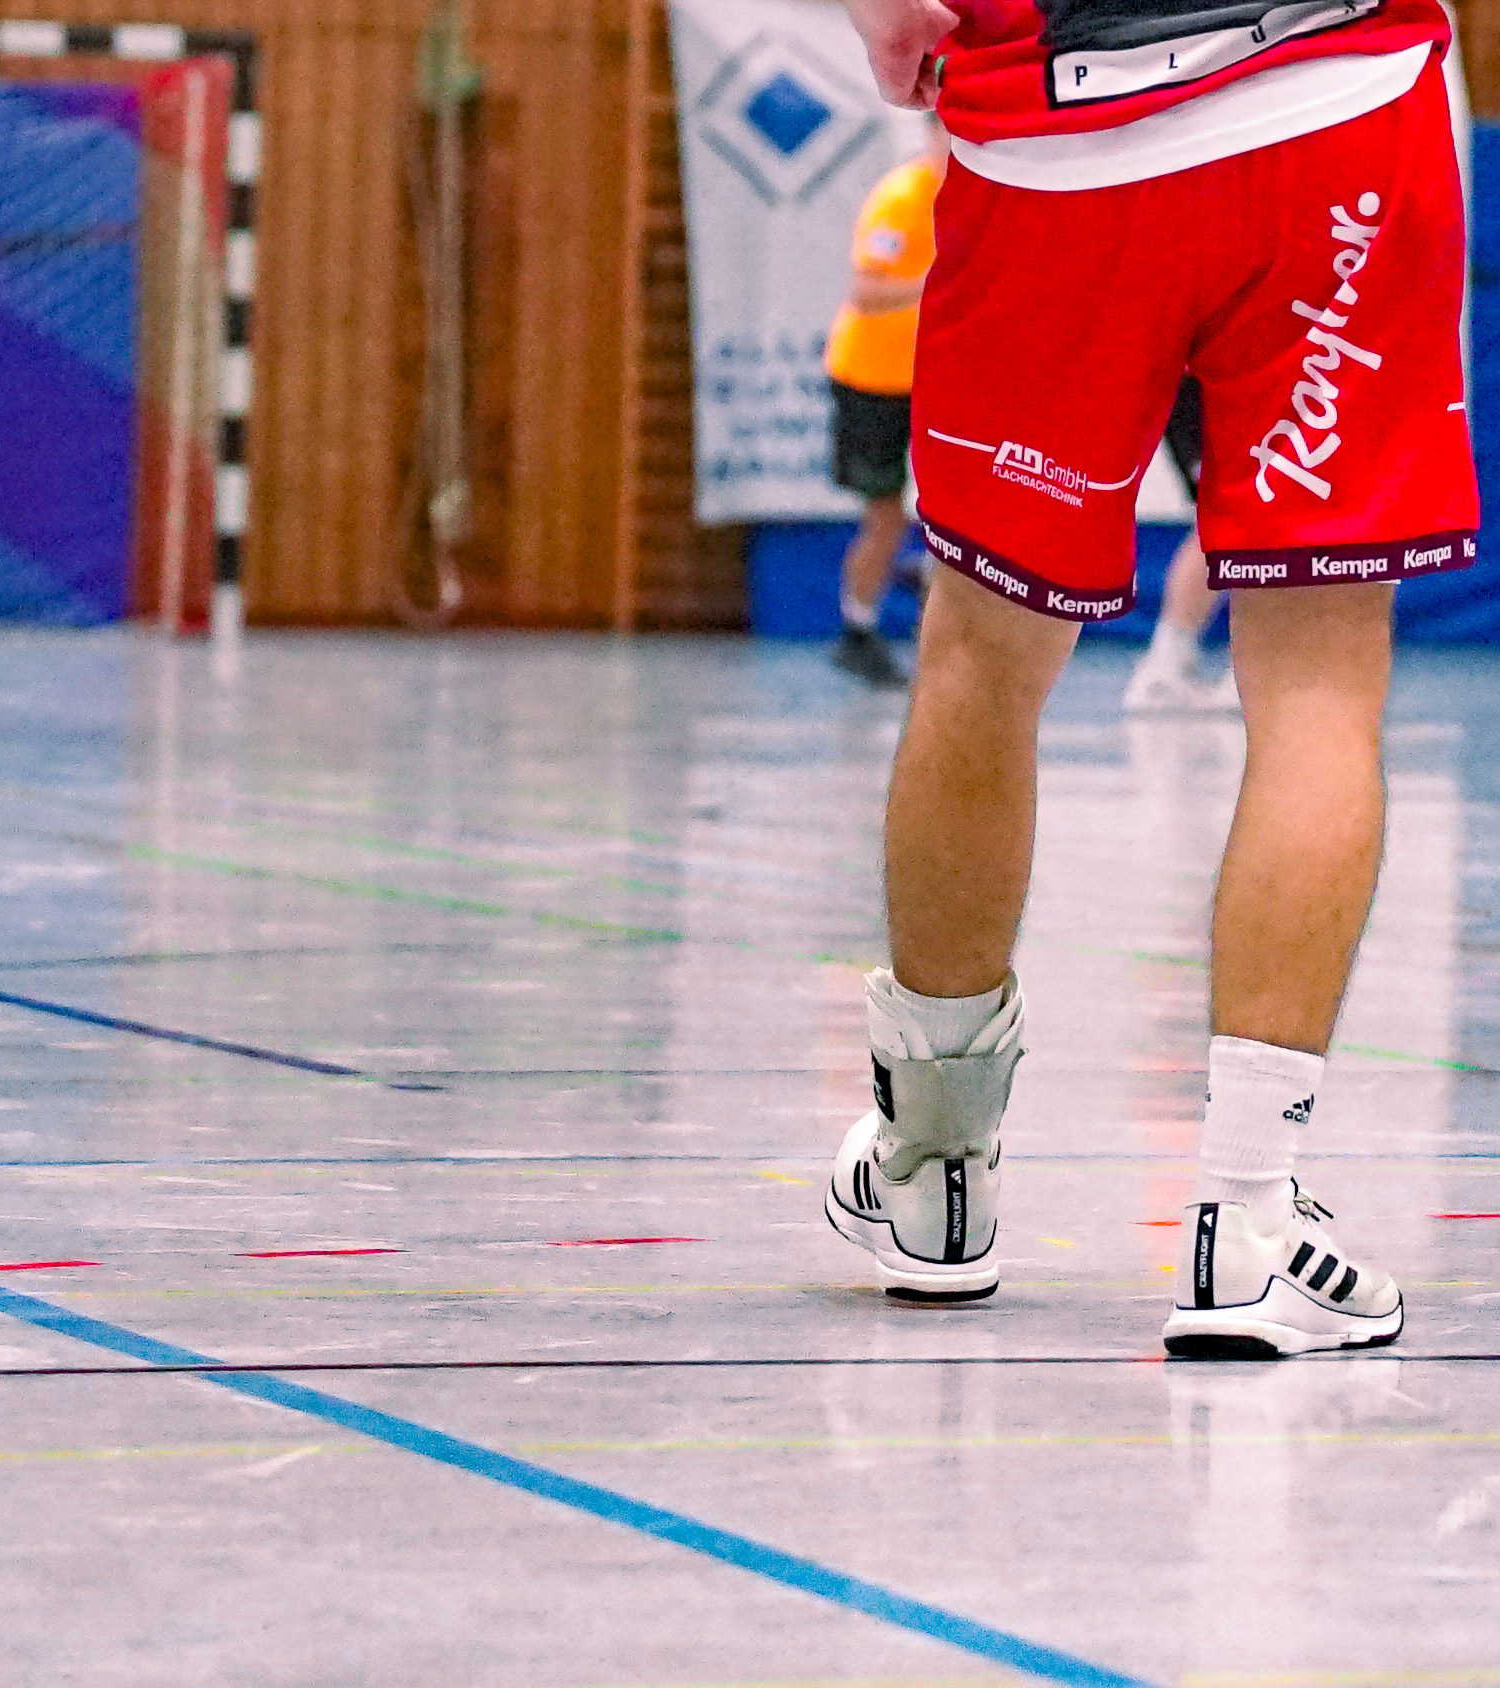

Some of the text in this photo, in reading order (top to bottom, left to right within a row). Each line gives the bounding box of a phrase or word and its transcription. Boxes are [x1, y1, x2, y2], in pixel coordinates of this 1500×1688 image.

[1043, 456, 1089, 494] GmbH
[1218, 558, 1289, 585] Kempa
[1310, 554, 1389, 579] Kempa
[1403, 544, 1453, 570] Kempa
[973, 553, 1030, 600] Kempa
[1045, 590, 1124, 620] Kempa
